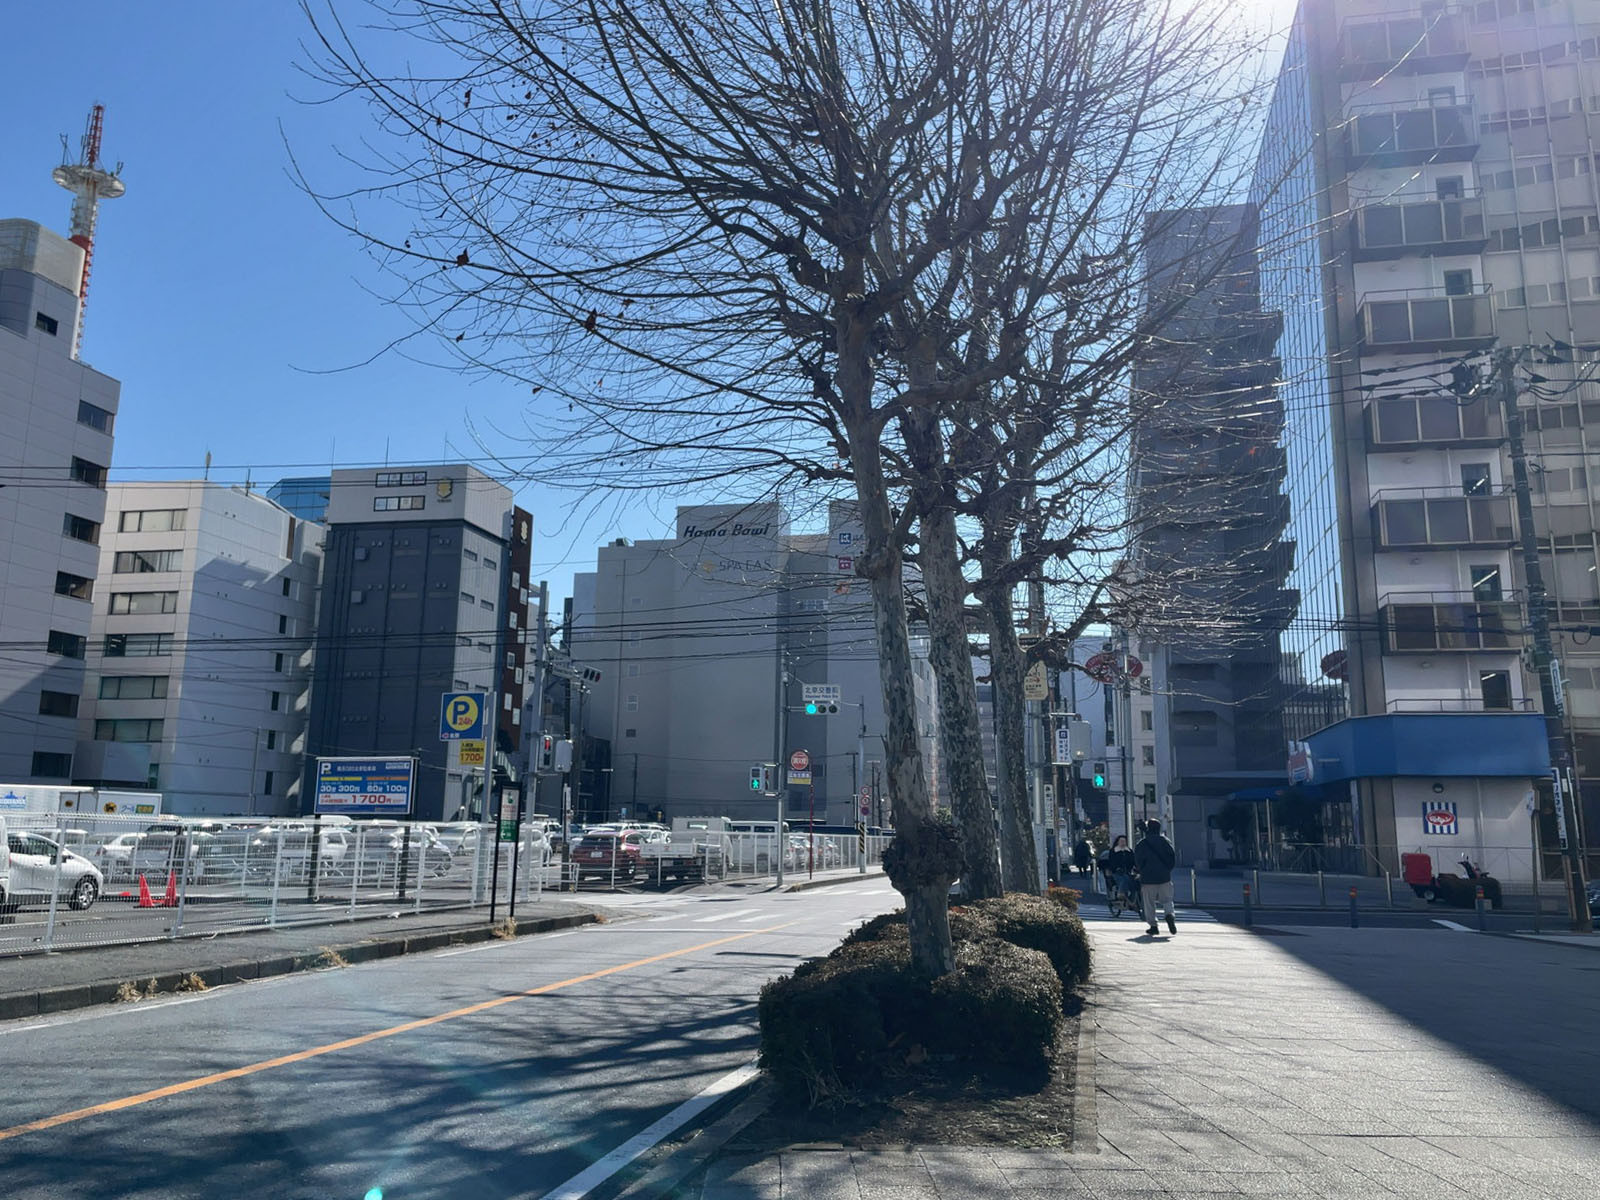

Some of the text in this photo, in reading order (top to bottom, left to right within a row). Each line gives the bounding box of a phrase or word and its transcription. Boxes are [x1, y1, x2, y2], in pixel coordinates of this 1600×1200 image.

[684, 522, 770, 538] Hama Bowl
[453, 701, 470, 724] P
